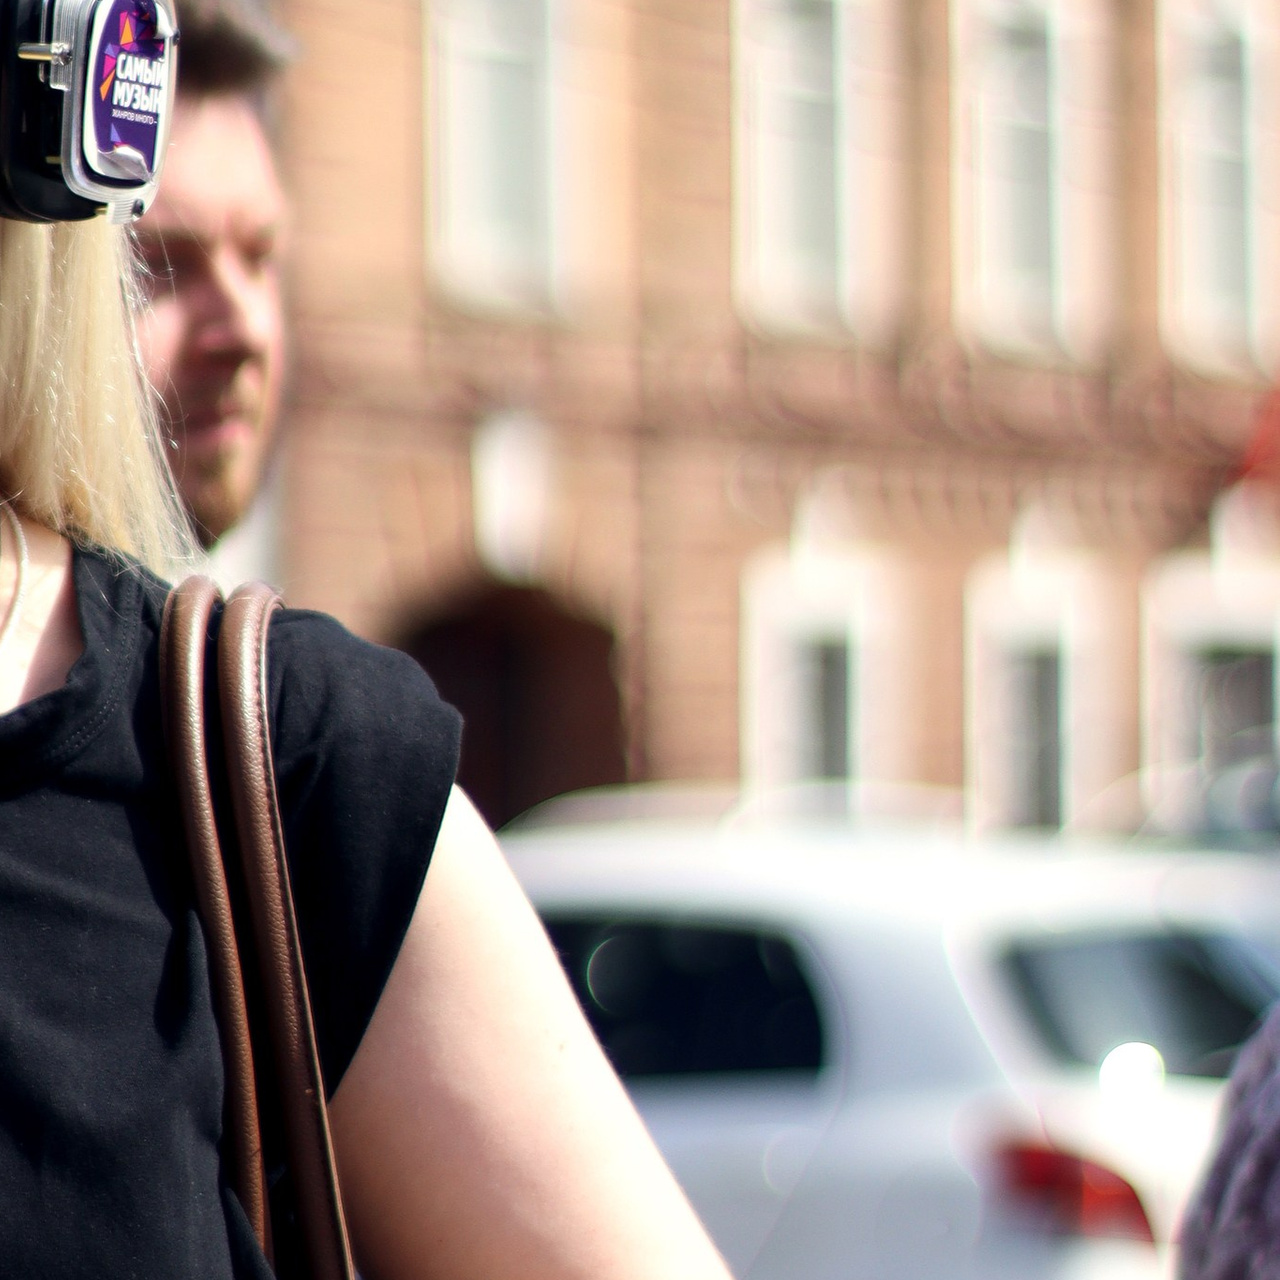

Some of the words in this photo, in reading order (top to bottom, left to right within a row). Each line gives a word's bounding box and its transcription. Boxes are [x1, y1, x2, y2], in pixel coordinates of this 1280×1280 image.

[116, 53, 165, 86] САМЫЙ
[111, 108, 135, 121] ЖАНРОВ
[134, 113, 154, 125] МНОГО
